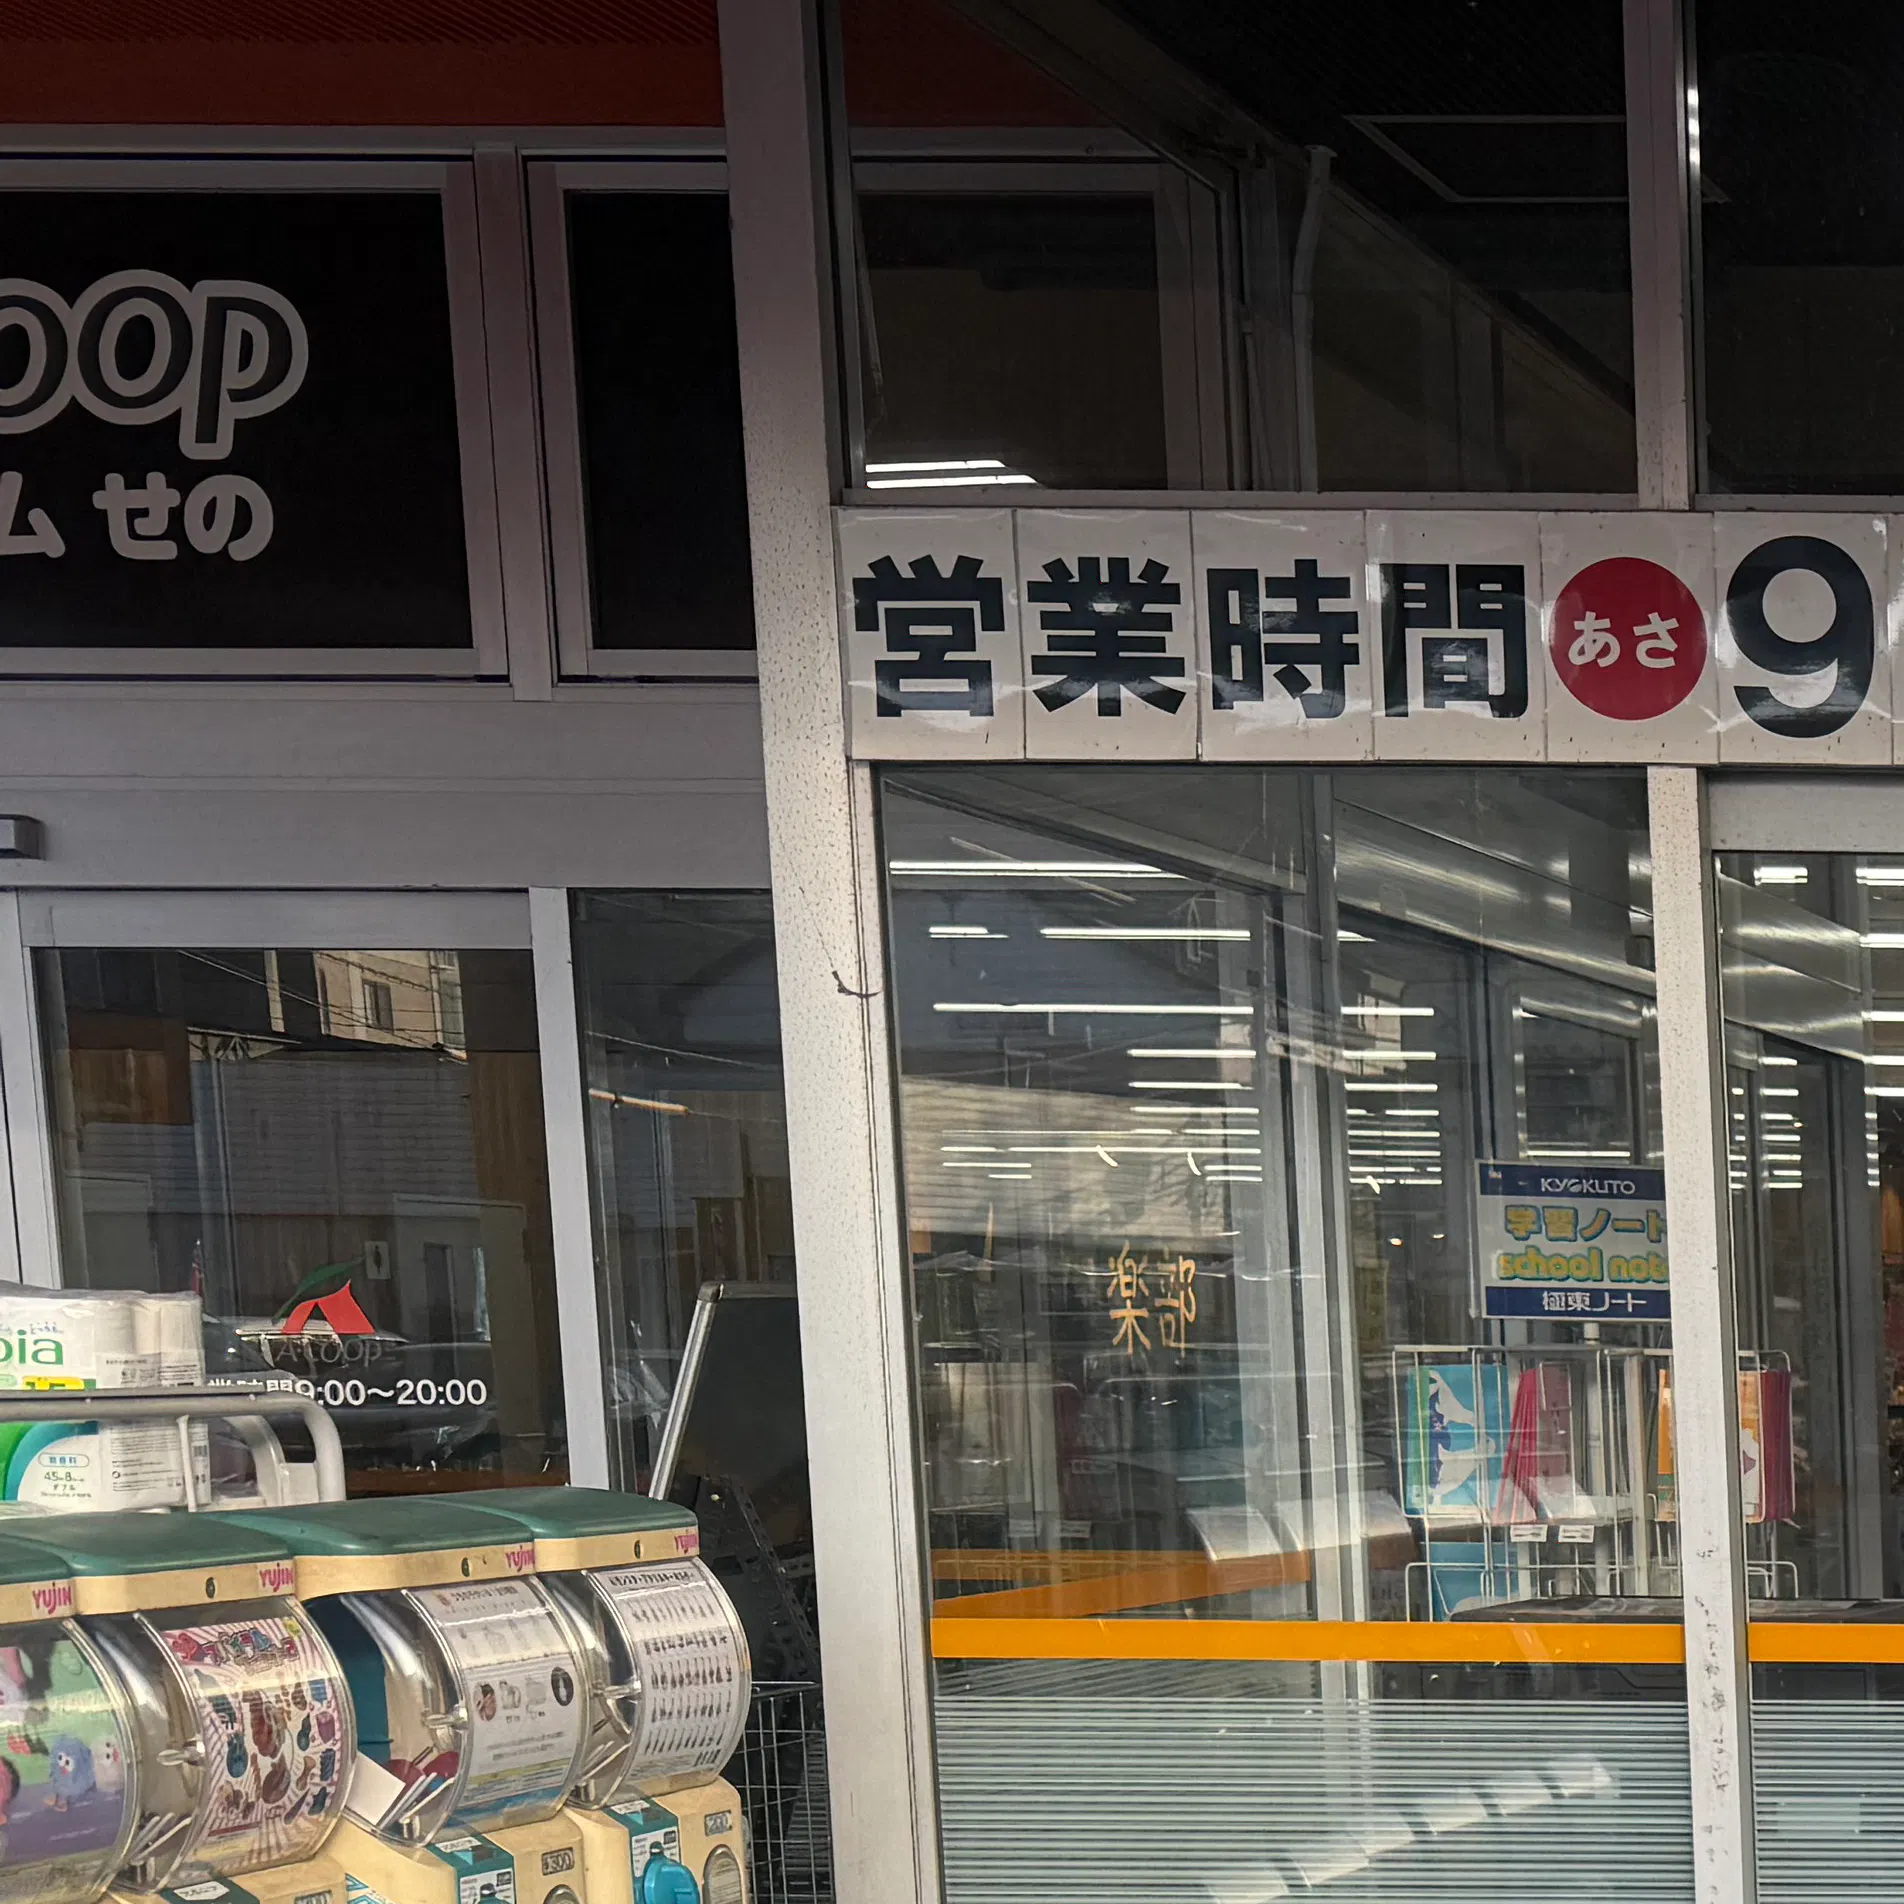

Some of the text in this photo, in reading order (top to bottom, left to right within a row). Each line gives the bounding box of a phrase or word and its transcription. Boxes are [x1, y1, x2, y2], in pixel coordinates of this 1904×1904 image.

[93, 473, 273, 561] せの
[853, 554, 1528, 720] 営業時間
[1497, 1245, 1604, 1282] school
[1542, 1291, 1647, 1312] 極東ノート
